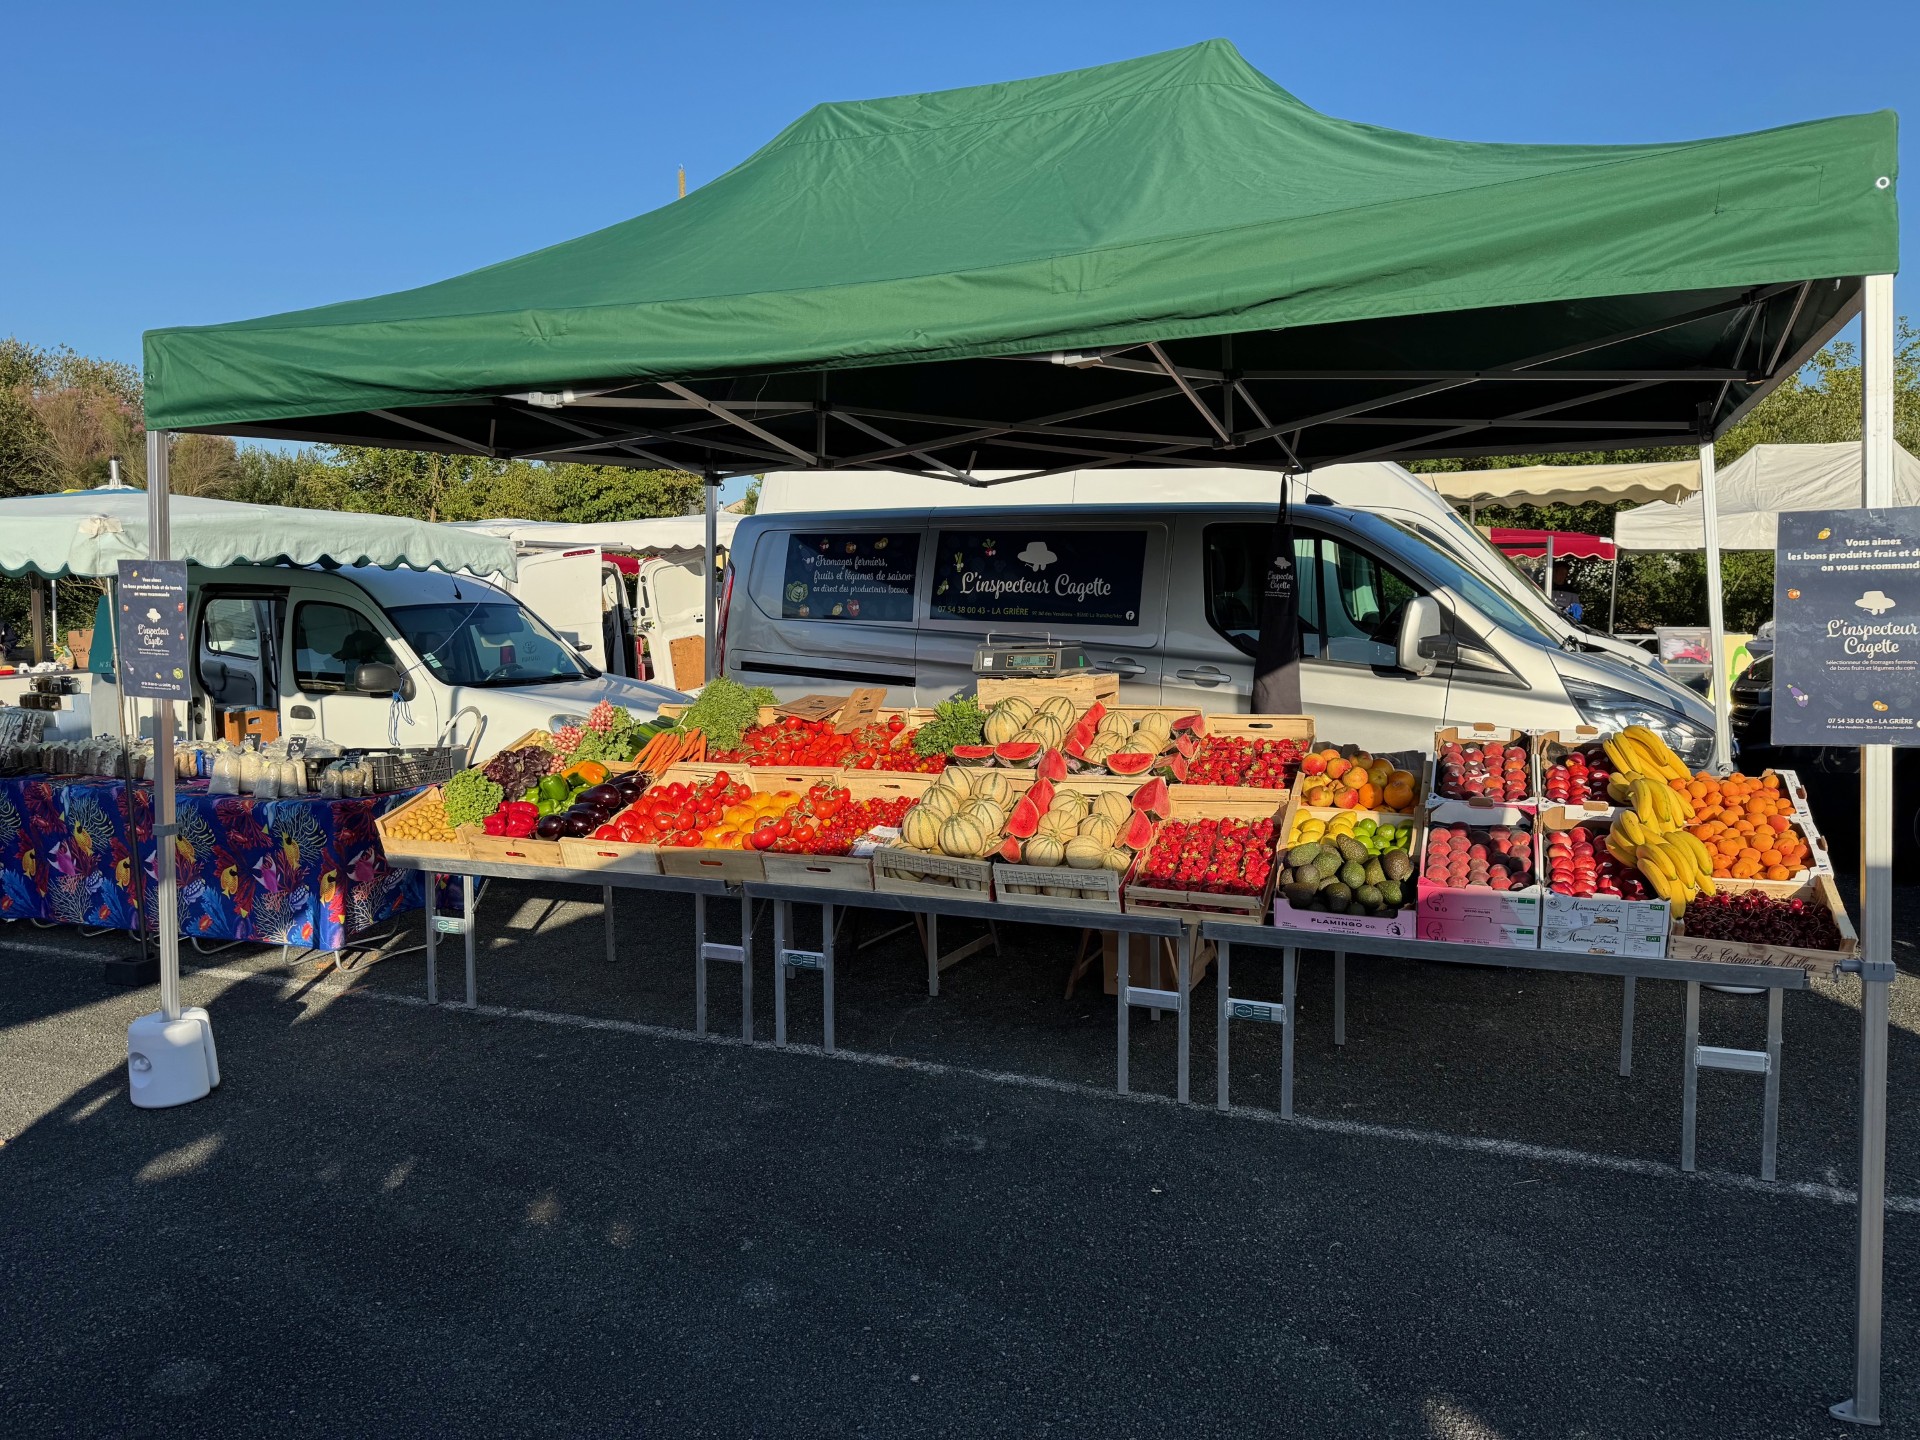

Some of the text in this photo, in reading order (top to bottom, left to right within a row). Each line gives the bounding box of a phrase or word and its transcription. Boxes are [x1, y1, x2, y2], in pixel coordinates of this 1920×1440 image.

[1846, 538, 1870, 546] Vous
[816, 554, 888, 569] Fromages fermiers,
[1788, 552, 1802, 560] les
[1829, 550, 1872, 561] produits
[1874, 549, 1896, 558] frais
[813, 569, 912, 584] fruits et légumes de saison
[821, 584, 838, 592] direct
[840, 584, 848, 592] des
[850, 586, 886, 595] producteurs
[960, 572, 1111, 602] L'inspecteur Cagette
[1003, 606, 1029, 615] GRIÈRE
[1826, 620, 1919, 641] L'inspecteur
[1844, 636, 1900, 658] Cagette
[1311, 918, 1362, 928] FLAMINGO
[1691, 944, 1712, 960] Les
[1719, 947, 1759, 965] Coteaux
[1761, 954, 1774, 966] de
[1776, 953, 1816, 971] Millau
